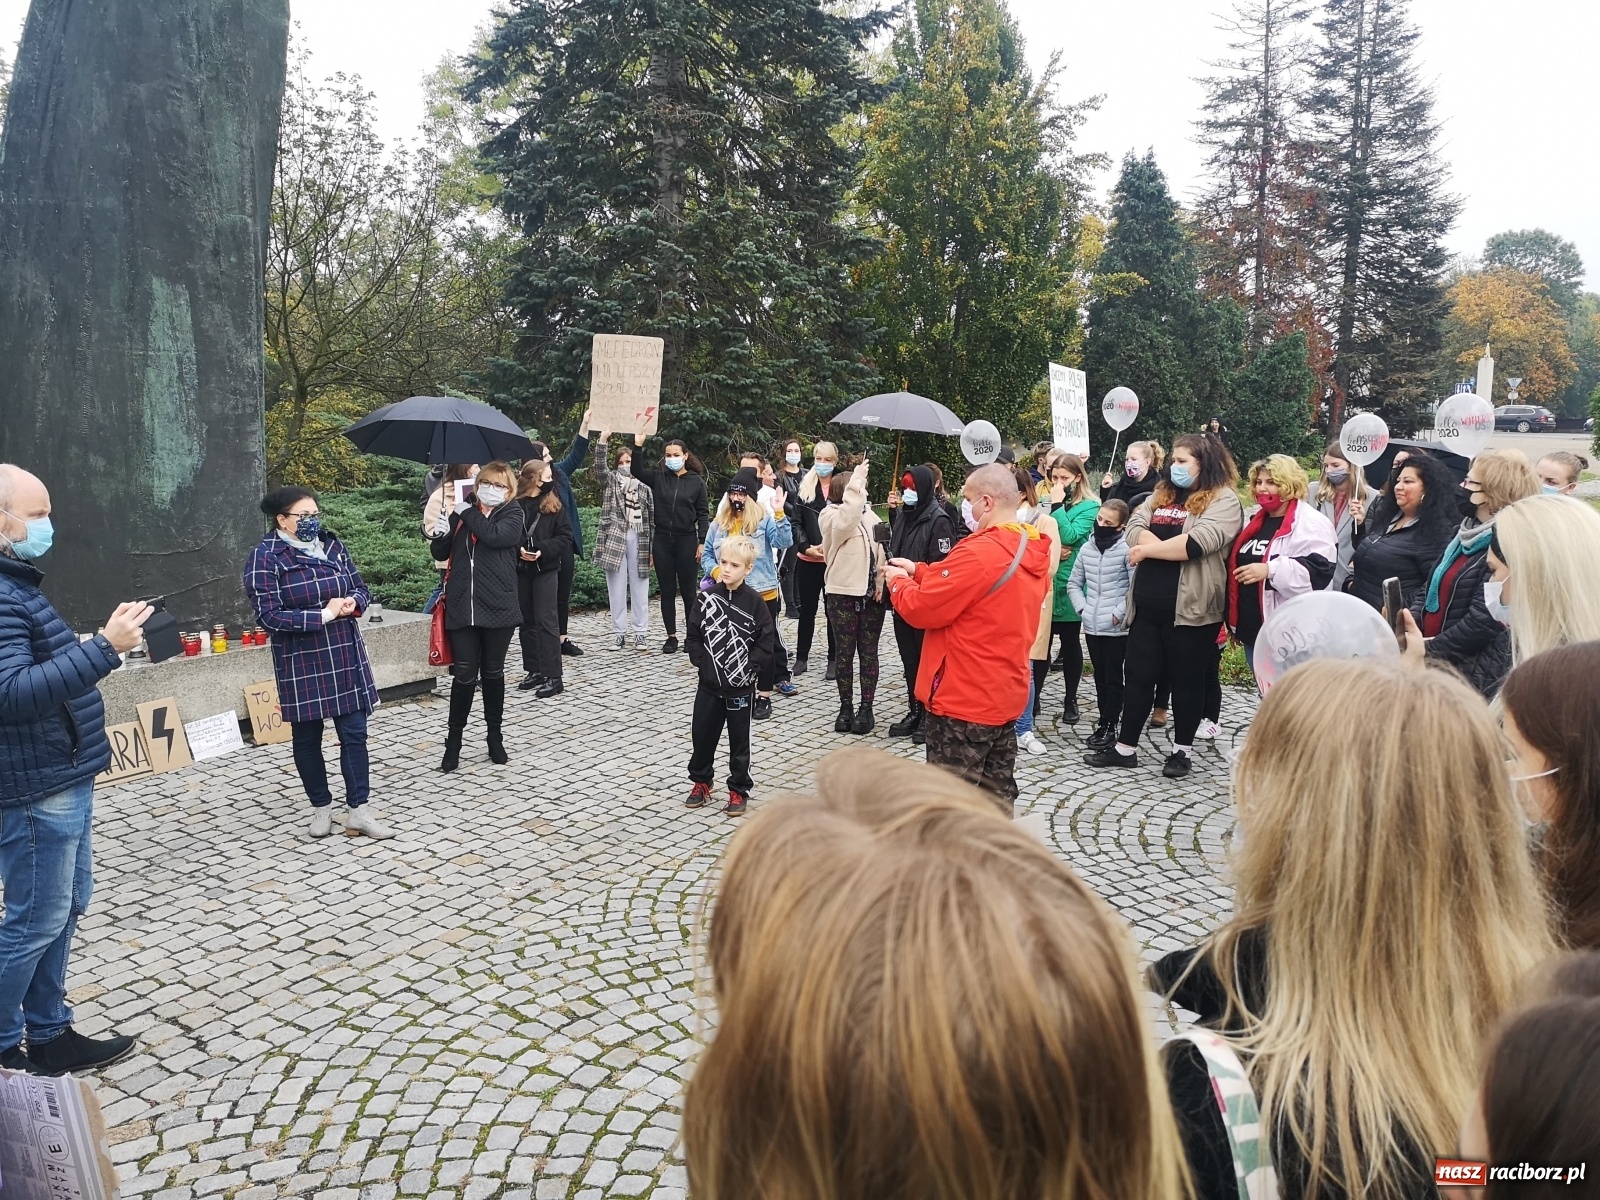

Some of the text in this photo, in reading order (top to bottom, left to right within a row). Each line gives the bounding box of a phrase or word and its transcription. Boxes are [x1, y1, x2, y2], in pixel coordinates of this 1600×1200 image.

[596, 339, 662, 359] MEFEDRON
[596, 362, 611, 378] MA
[1053, 386, 1076, 410] WOLNEJ
[973, 445, 994, 456] 2020
[1346, 444, 1368, 452] 2020
[1239, 538, 1270, 556] NAS
[251, 690, 271, 705] TO
[256, 712, 283, 734] WO
[48, 1143, 63, 1154] E
